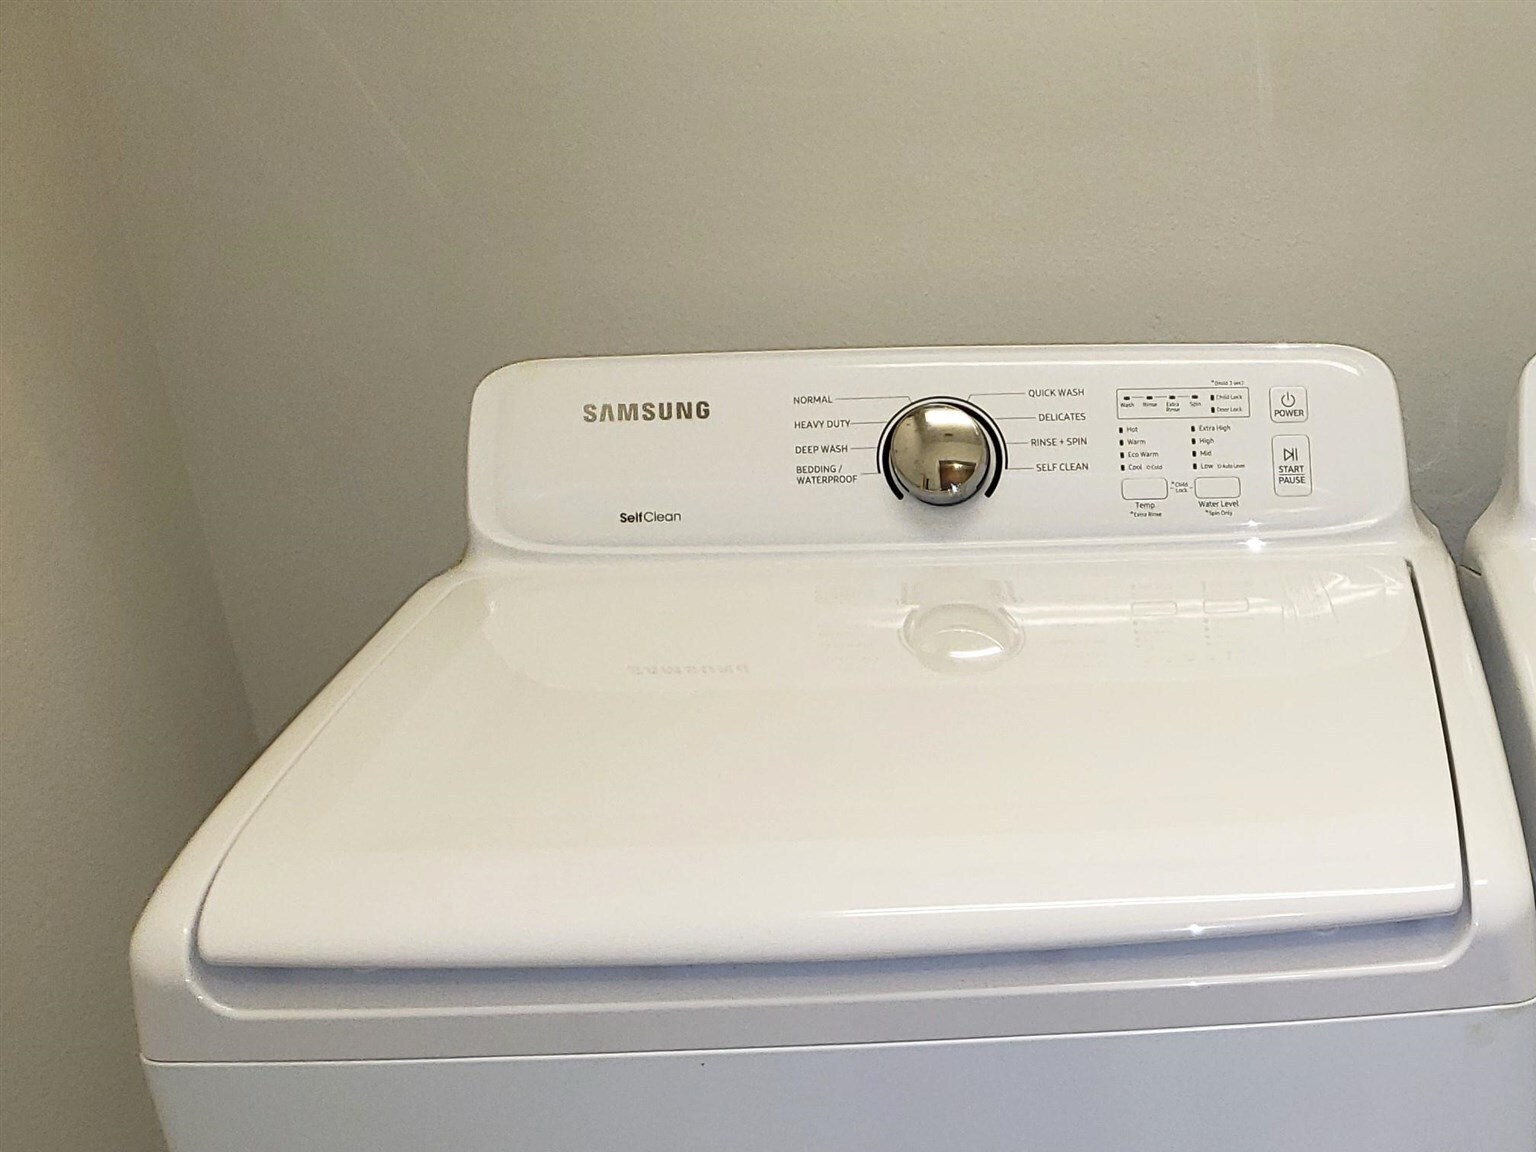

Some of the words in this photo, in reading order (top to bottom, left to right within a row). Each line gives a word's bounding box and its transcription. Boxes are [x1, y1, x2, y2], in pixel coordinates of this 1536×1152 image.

[1028, 388, 1055, 398] QUICK
[1057, 388, 1085, 398] WASH
[792, 394, 833, 406] NORMAL
[582, 400, 712, 423] SAMSUNG
[1274, 409, 1304, 417] POWER
[1037, 412, 1086, 423] DELICATES
[793, 419, 825, 430] HEAVY
[826, 418, 850, 429] DUTY
[1030, 437, 1057, 448] RINSE
[1067, 437, 1088, 447] SPIN
[794, 444, 819, 455] DEEP
[821, 443, 849, 454] WASH
[795, 464, 837, 475] BEDDING
[838, 464, 844, 474] /
[1035, 462, 1057, 472] SELF
[1059, 462, 1089, 472] CLEAN
[1278, 465, 1304, 473] START
[795, 474, 858, 485] WATERPROOF
[1278, 476, 1306, 484] PAUSE
[619, 510, 682, 524] SelfClean
